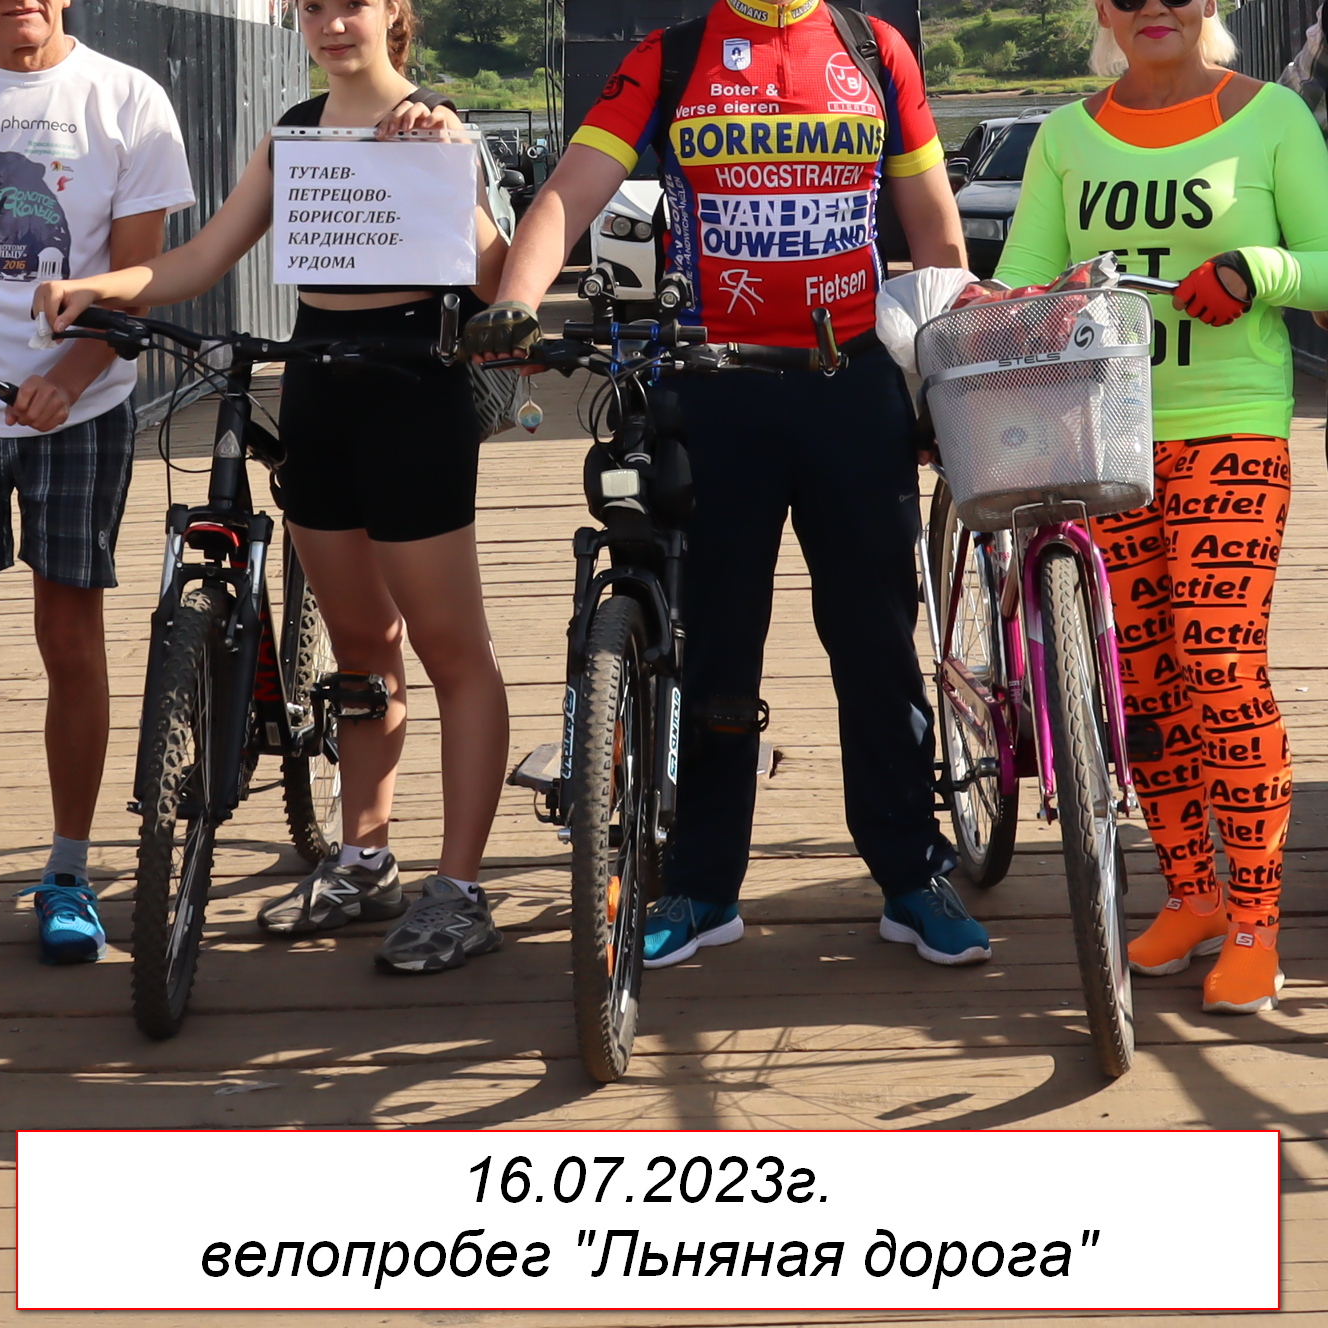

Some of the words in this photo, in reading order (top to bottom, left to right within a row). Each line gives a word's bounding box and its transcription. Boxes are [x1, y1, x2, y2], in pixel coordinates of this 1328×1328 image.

[710, 83, 760, 97] Boter
[766, 83, 779, 96] &
[675, 100, 716, 119] Verse
[723, 99, 780, 114] eieren
[1, 115, 78, 134] pharmeco
[678, 120, 883, 159] BORREMANS
[288, 166, 356, 180] ТУТАЕВ-
[715, 164, 864, 189] HOOGSTRATEN
[287, 188, 392, 204] ПЕТРЕЦОВО-
[1078, 177, 1215, 231] VOUS
[287, 209, 401, 225] БОРИСОГЛЕБ-
[716, 197, 782, 228] VAN
[796, 197, 855, 223] DEN
[287, 231, 404, 248] КАРДИНСКОЕ-
[704, 222, 870, 258] OUWELAND
[2, 260, 27, 270] 2016
[287, 256, 356, 271] УРДОМА
[805, 268, 867, 307] Fietsen
[998, 352, 1061, 368] STELS
[1210, 452, 1290, 481] Actie
[1165, 490, 1267, 517] Actie!
[1191, 534, 1280, 563] Actie
[1171, 574, 1252, 600] ctie!
[1123, 684, 1189, 714] Acti
[1202, 696, 1280, 725] Actie
[1202, 736, 1264, 763] tie!
[1131, 758, 1200, 790] Acti
[1210, 776, 1292, 804] Actie
[1221, 817, 1266, 843] tie!
[1228, 859, 1283, 885] Actie
